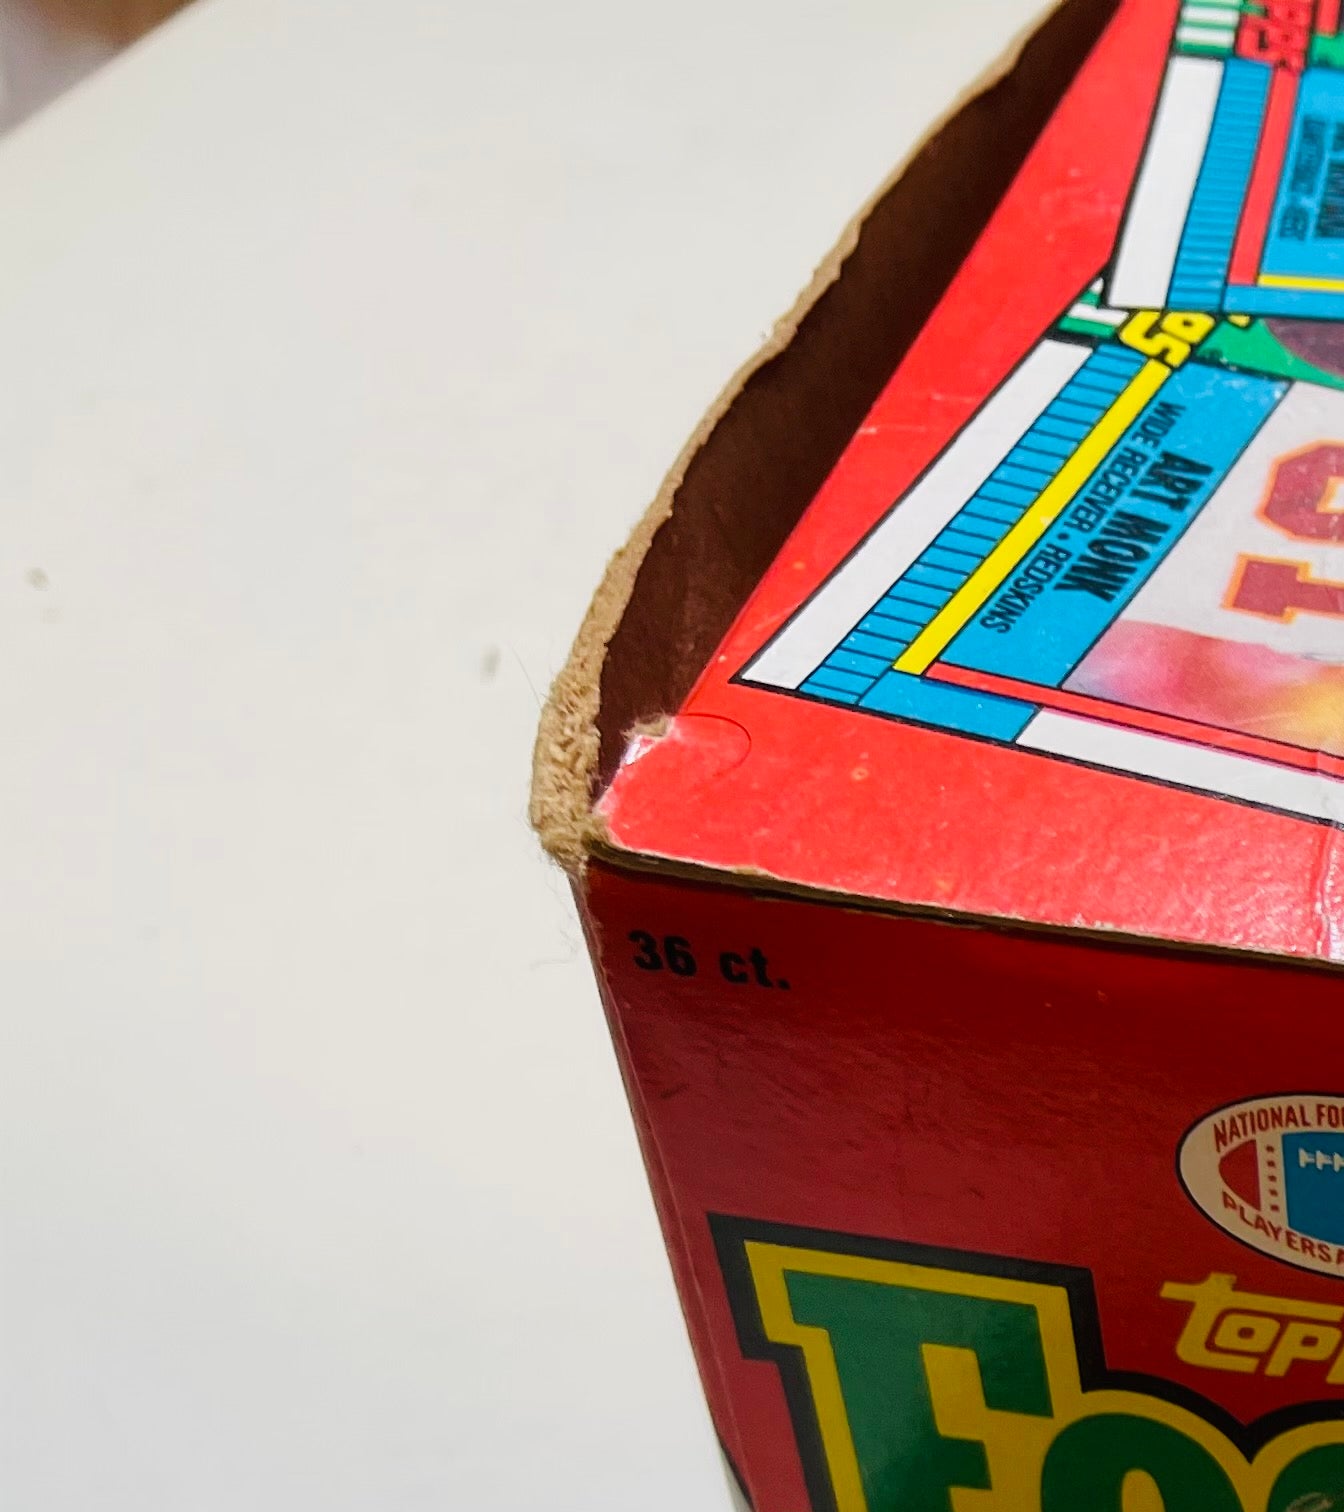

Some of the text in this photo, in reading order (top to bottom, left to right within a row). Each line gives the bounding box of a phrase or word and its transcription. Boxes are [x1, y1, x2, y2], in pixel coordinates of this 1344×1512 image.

[1131, 400, 1187, 455] WIDE
[1064, 447, 1149, 535] RECEIVER
[1130, 452, 1214, 513] ART
[980, 542, 1073, 634] REDSKINS
[1053, 511, 1172, 603] MONK
[628, 929, 791, 991] 36 ct.
[1213, 1104, 1311, 1153] NATIONAL
[1222, 1191, 1333, 1263] PLAYERS
